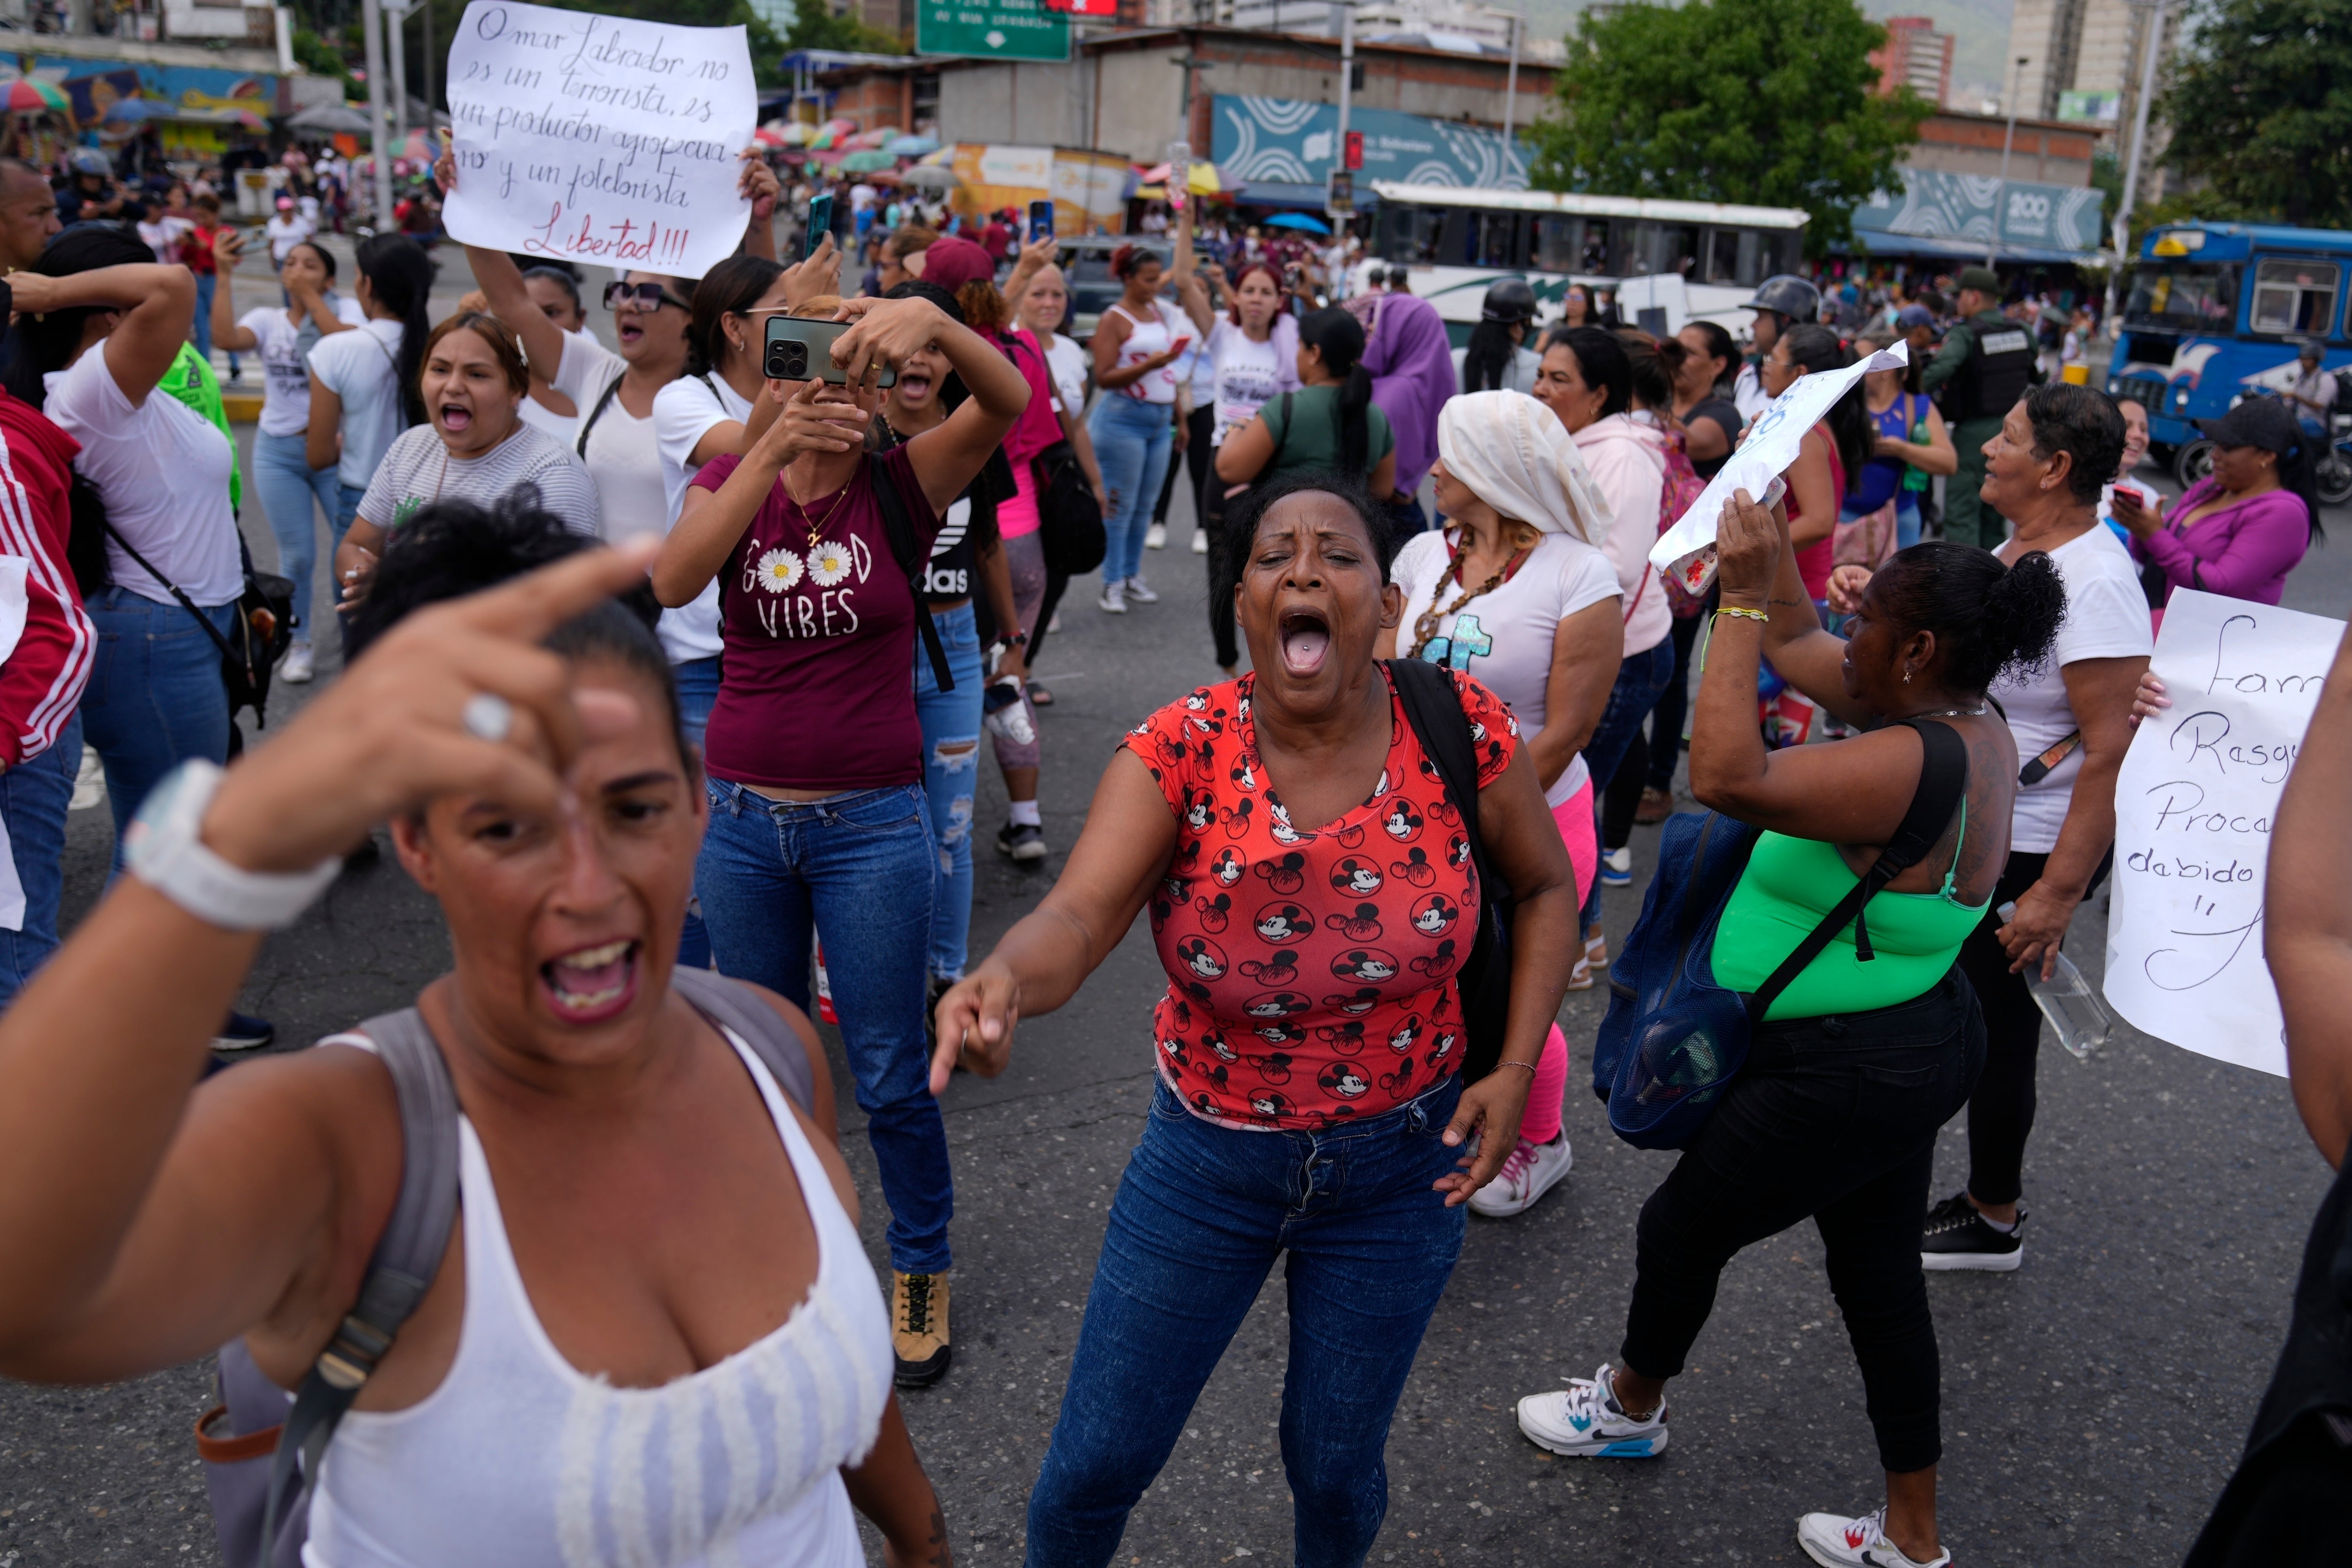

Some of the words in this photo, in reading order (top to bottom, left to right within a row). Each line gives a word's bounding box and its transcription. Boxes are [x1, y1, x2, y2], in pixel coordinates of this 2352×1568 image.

[478, 7, 568, 49] Omar
[559, 15, 683, 85] Labrador
[462, 61, 494, 82] es
[504, 68, 541, 89] un
[679, 98, 713, 123] es
[451, 101, 484, 126] un
[493, 101, 608, 143] productor
[499, 161, 519, 199] y
[528, 164, 560, 185] un
[2008, 191, 2050, 220] 200
[758, 588, 859, 638] VIBES
